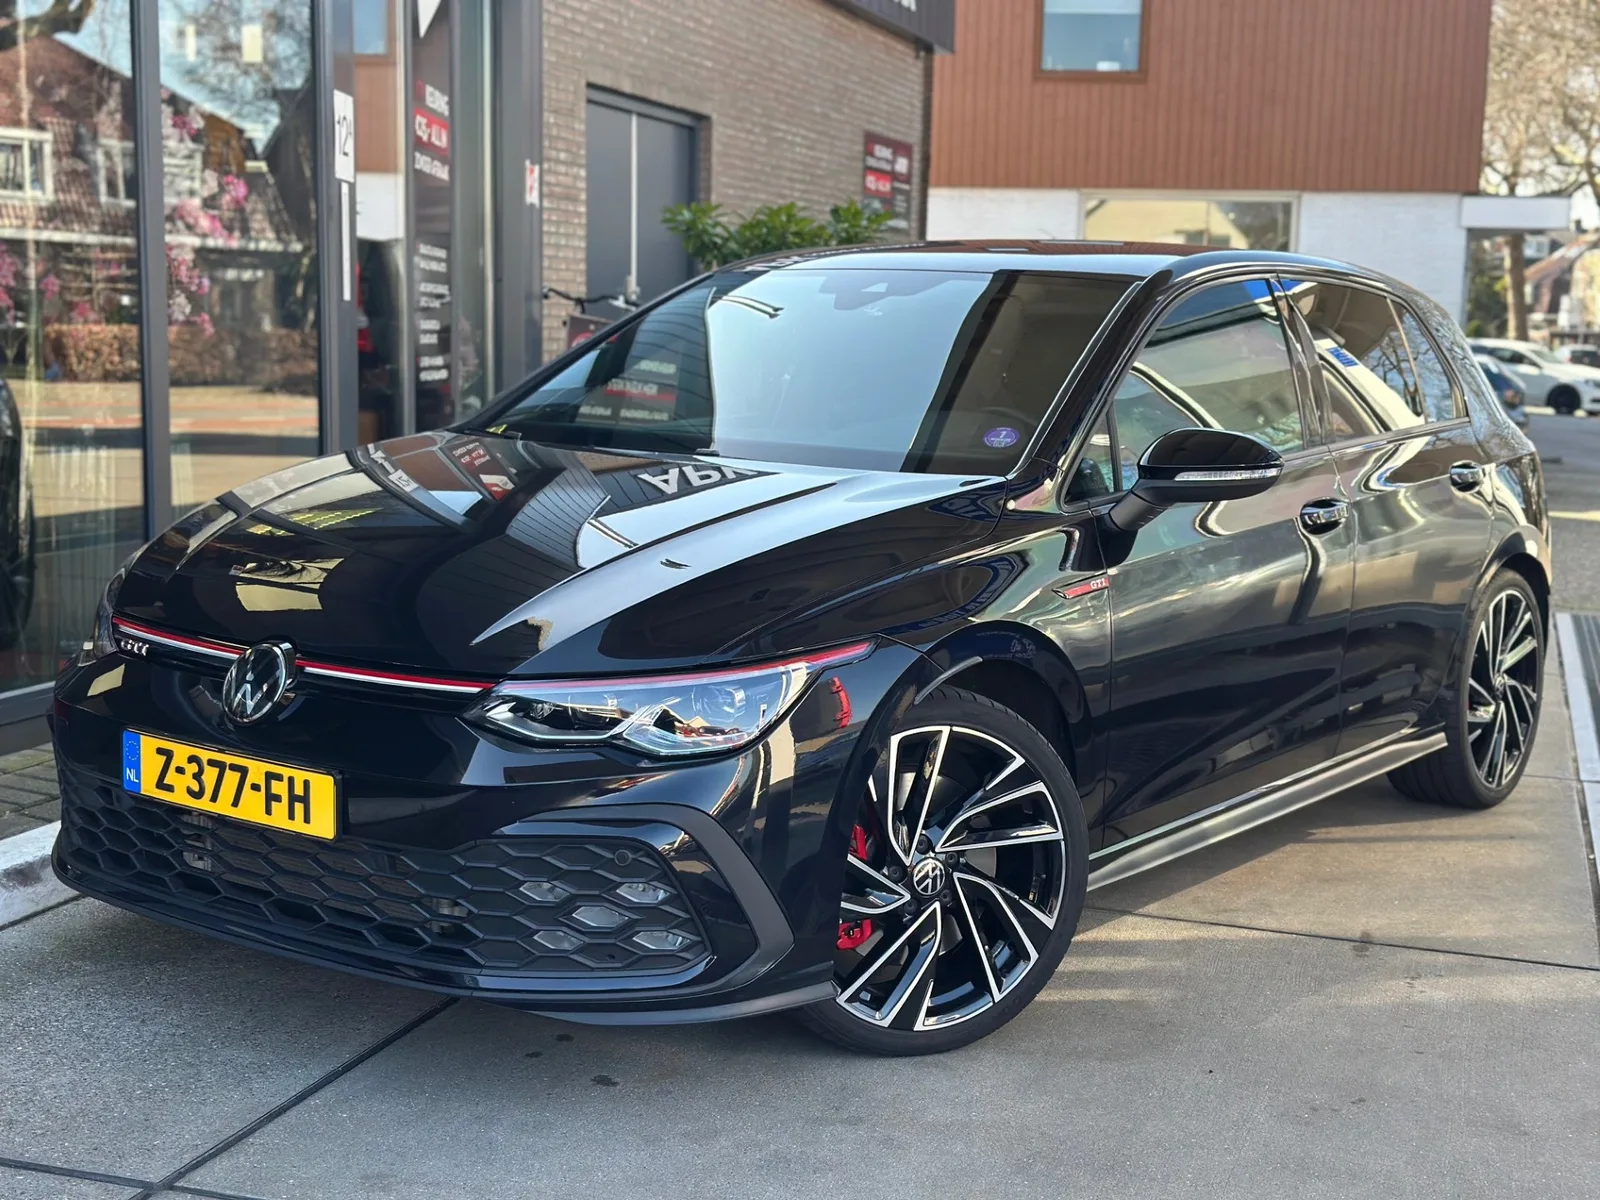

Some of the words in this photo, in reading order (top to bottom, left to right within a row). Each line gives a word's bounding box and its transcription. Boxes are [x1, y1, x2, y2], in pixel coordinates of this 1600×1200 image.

[1090, 578, 1106, 589] GTI
[126, 767, 140, 783] NL
[155, 746, 311, 825] Z-377-FH
